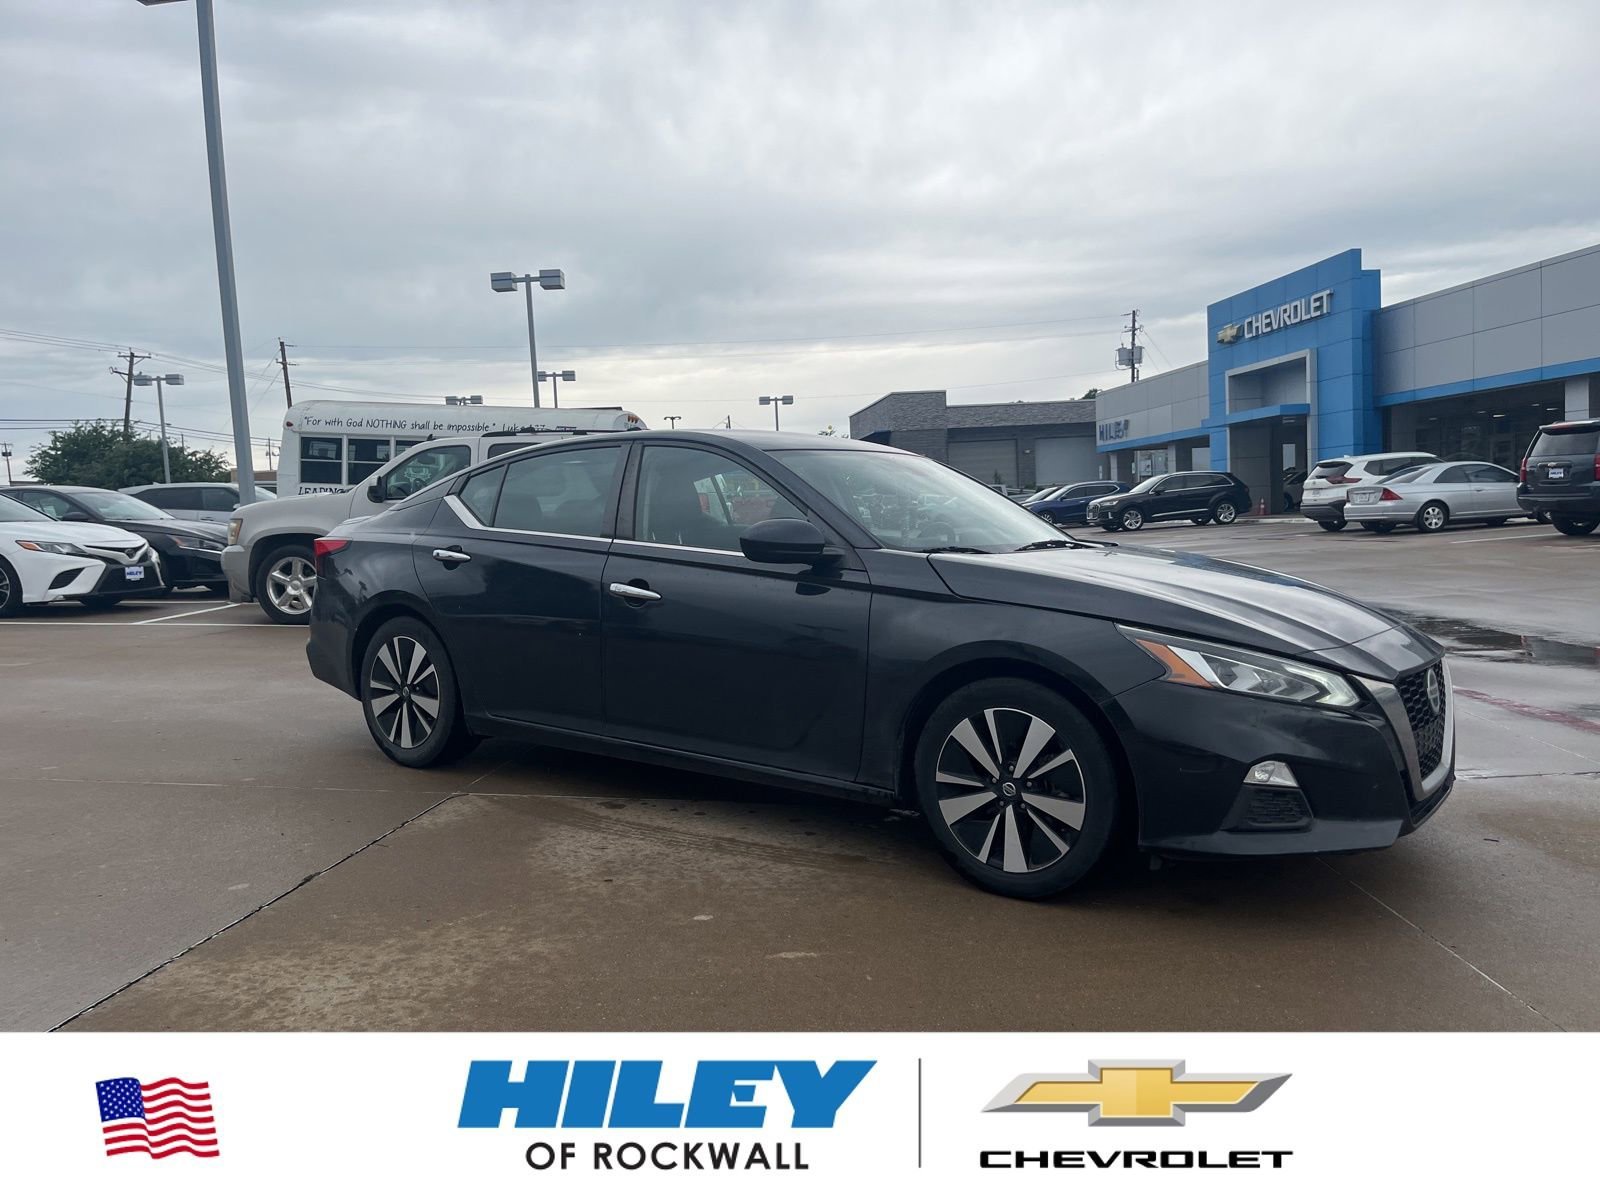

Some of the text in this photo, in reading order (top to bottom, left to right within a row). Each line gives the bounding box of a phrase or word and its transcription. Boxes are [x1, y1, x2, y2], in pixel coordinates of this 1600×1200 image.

[1244, 289, 1331, 339] CHEVROLET
[325, 417, 343, 428] with
[346, 417, 364, 428] God
[366, 418, 408, 430] NOTHING
[411, 420, 431, 430] shall
[433, 421, 444, 431] be
